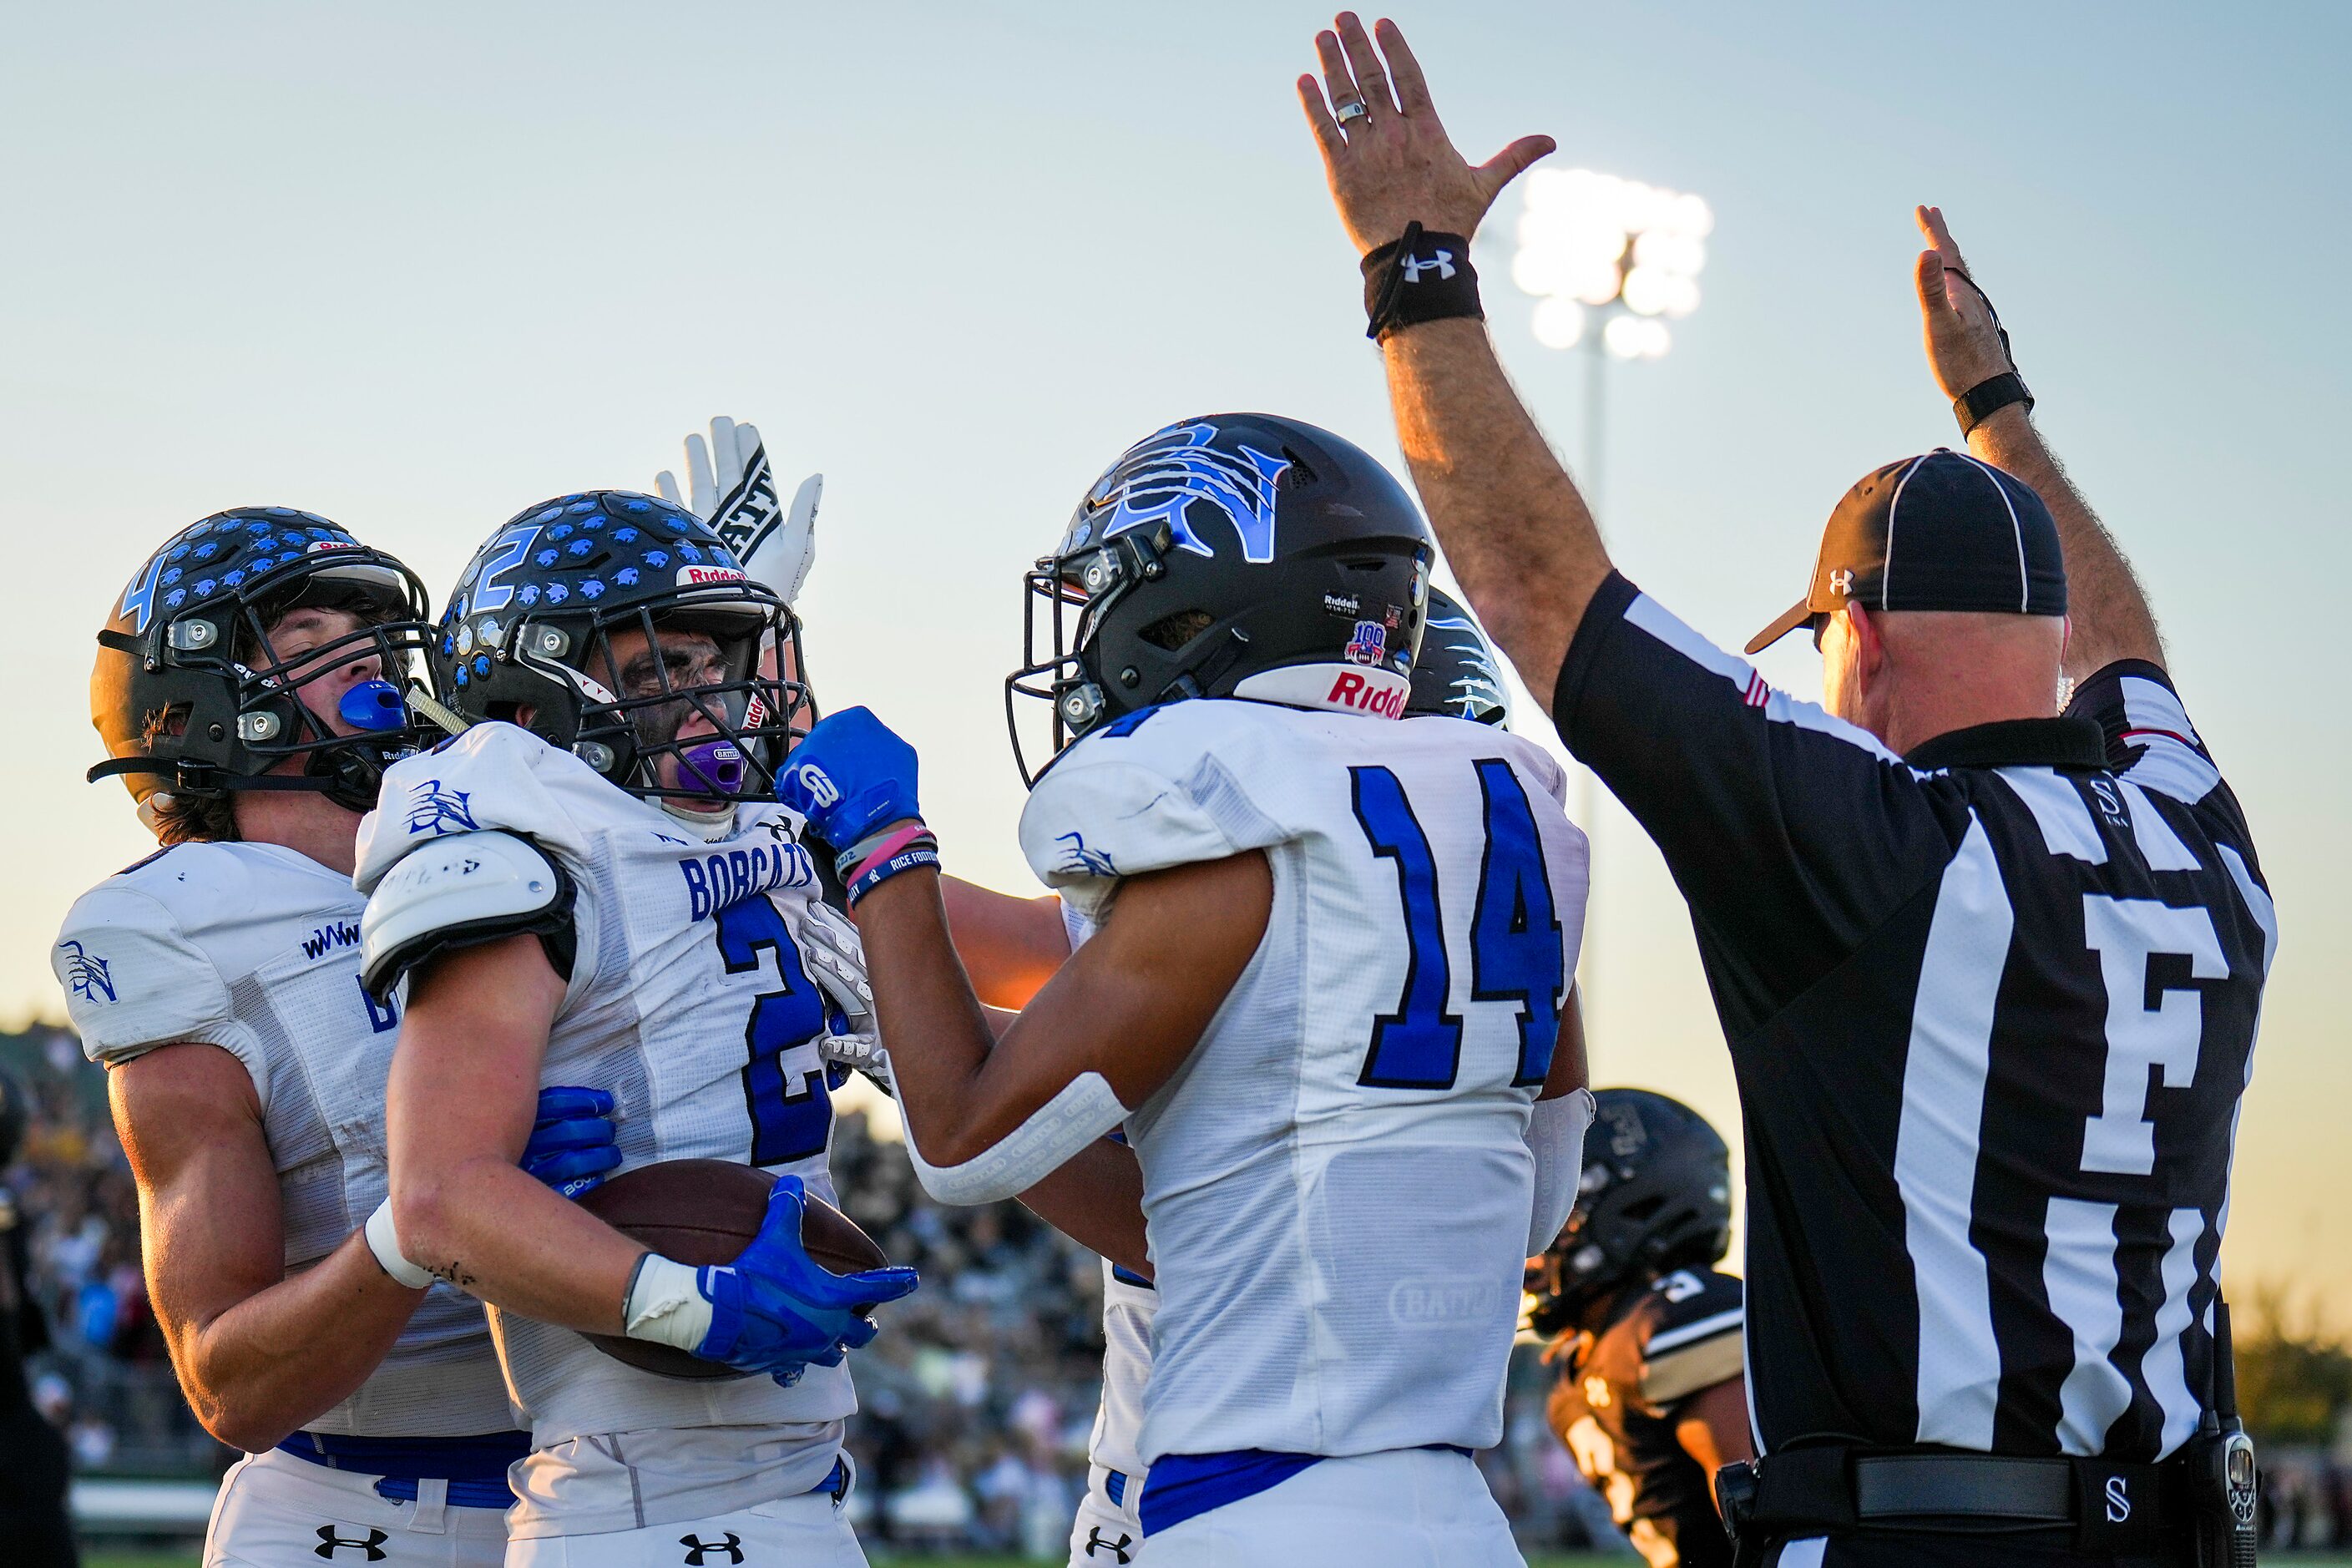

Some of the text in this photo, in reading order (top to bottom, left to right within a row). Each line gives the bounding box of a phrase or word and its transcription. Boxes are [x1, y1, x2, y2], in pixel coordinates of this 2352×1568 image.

[119, 552, 169, 637] 4
[472, 525, 544, 615] 2
[1324, 594, 1358, 609] Riddell
[1355, 625, 1383, 647] 100
[679, 843, 813, 923] BOBCATS
[890, 854, 913, 871] RICE
[1347, 757, 1565, 1090] 14
[711, 893, 833, 1168] 2
[2080, 893, 2230, 1176] F
